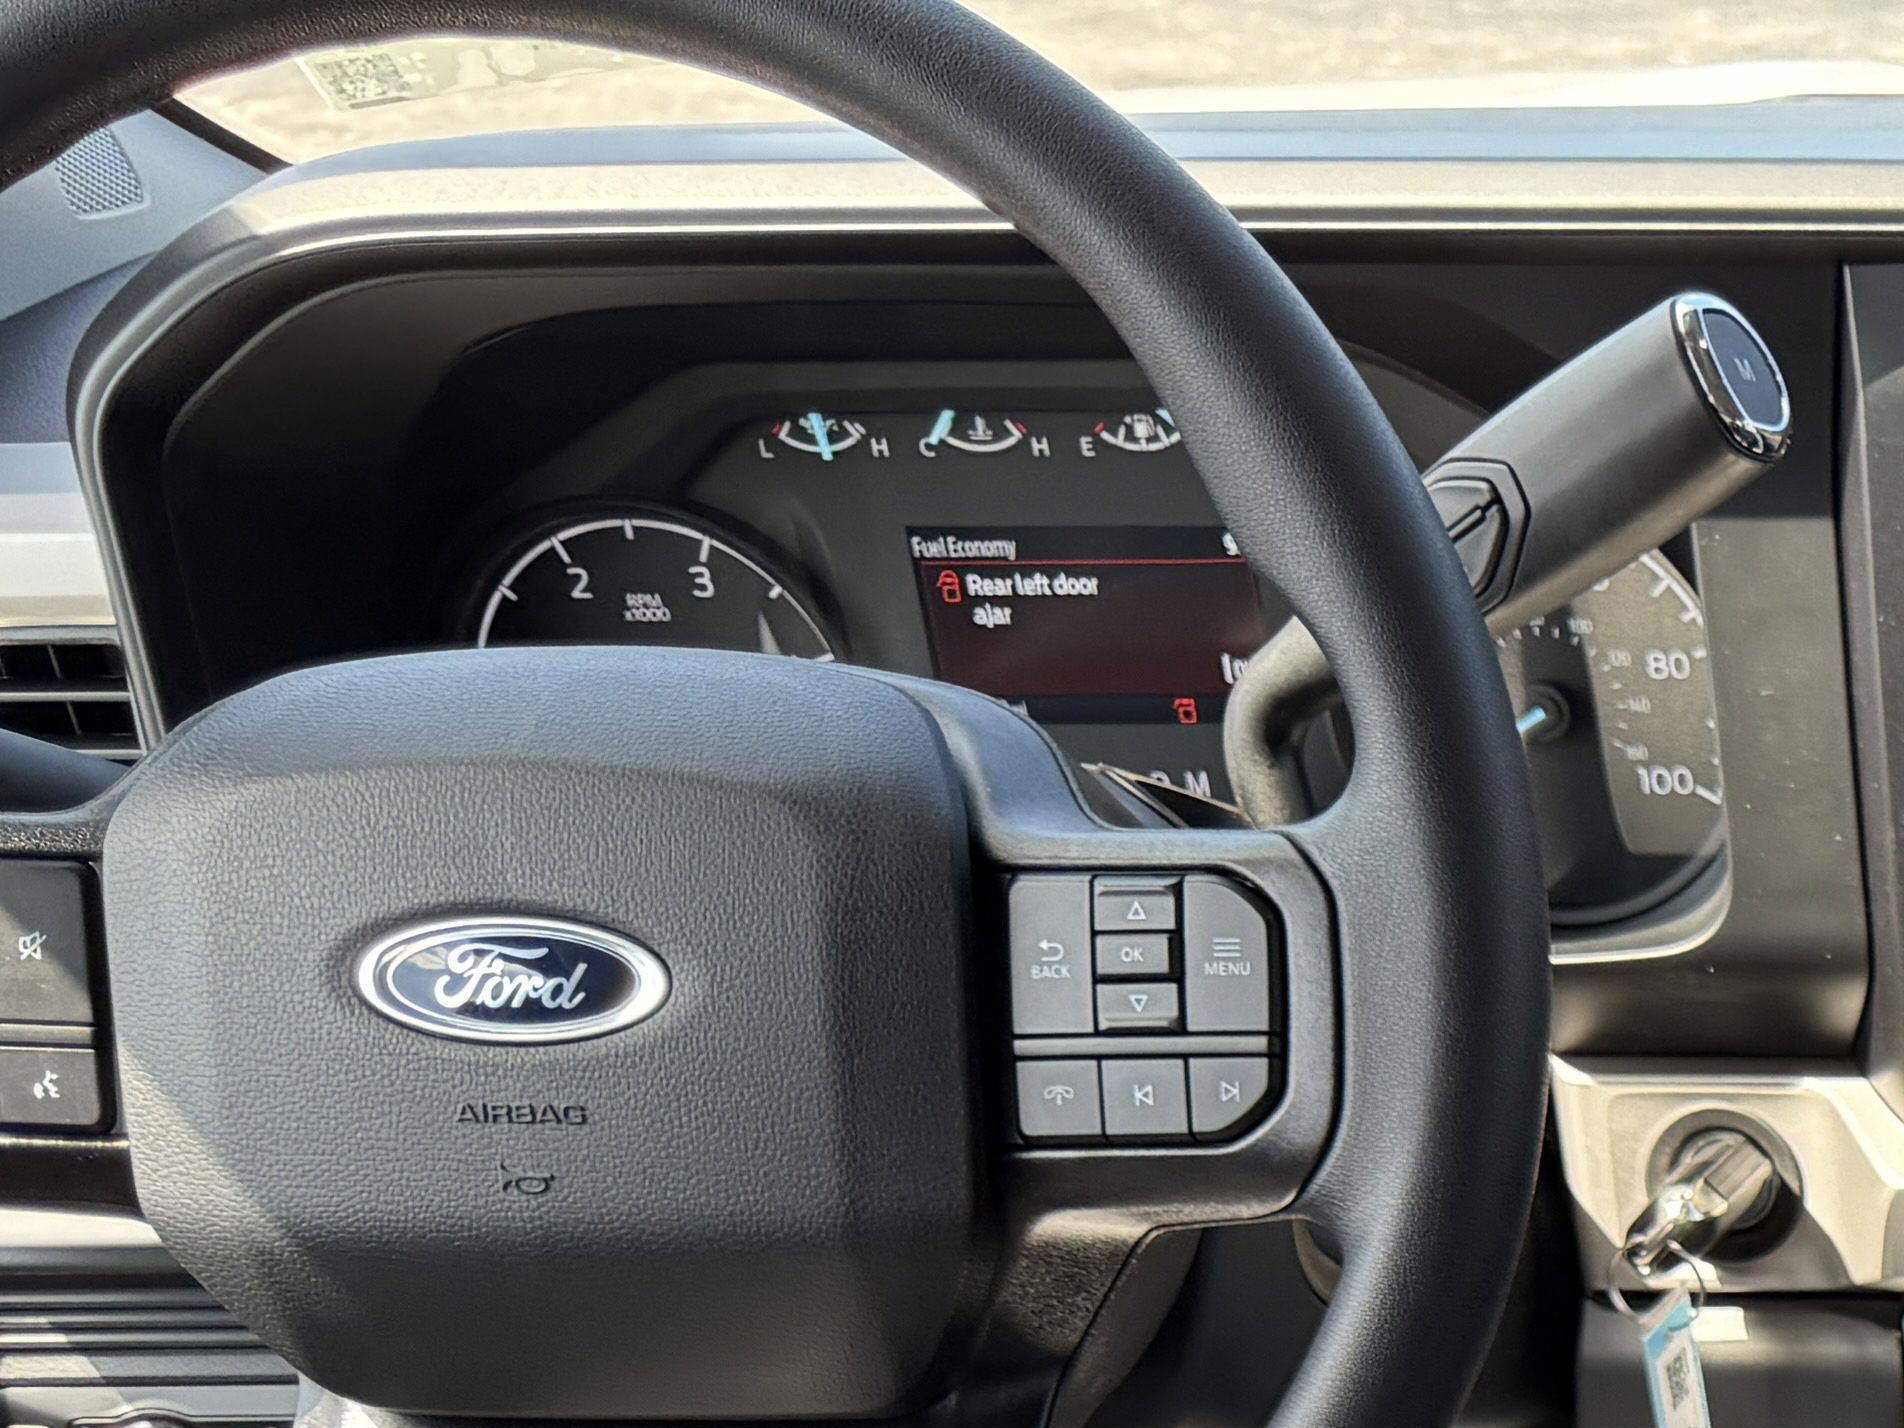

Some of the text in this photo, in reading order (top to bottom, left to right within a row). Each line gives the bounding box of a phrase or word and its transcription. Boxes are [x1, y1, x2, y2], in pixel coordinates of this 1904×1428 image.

[759, 439, 775, 459] L
[871, 439, 889, 457] H
[919, 438, 937, 458] C
[1032, 438, 1050, 457] H
[1080, 437, 1096, 457] E
[910, 536, 1017, 561] Fuel Economy
[566, 567, 594, 599] 2
[688, 566, 715, 598] 3
[965, 571, 1099, 596] Rear left door
[625, 593, 664, 607] RPM
[972, 602, 1013, 629] ajar
[1646, 651, 1691, 680] 80
[1636, 765, 1694, 795] 100
[1121, 946, 1144, 962] OK
[434, 942, 588, 1010] Ford
[1031, 963, 1071, 979] BACK
[1204, 961, 1250, 976] MENU
[456, 1102, 589, 1126] AIRBAG
